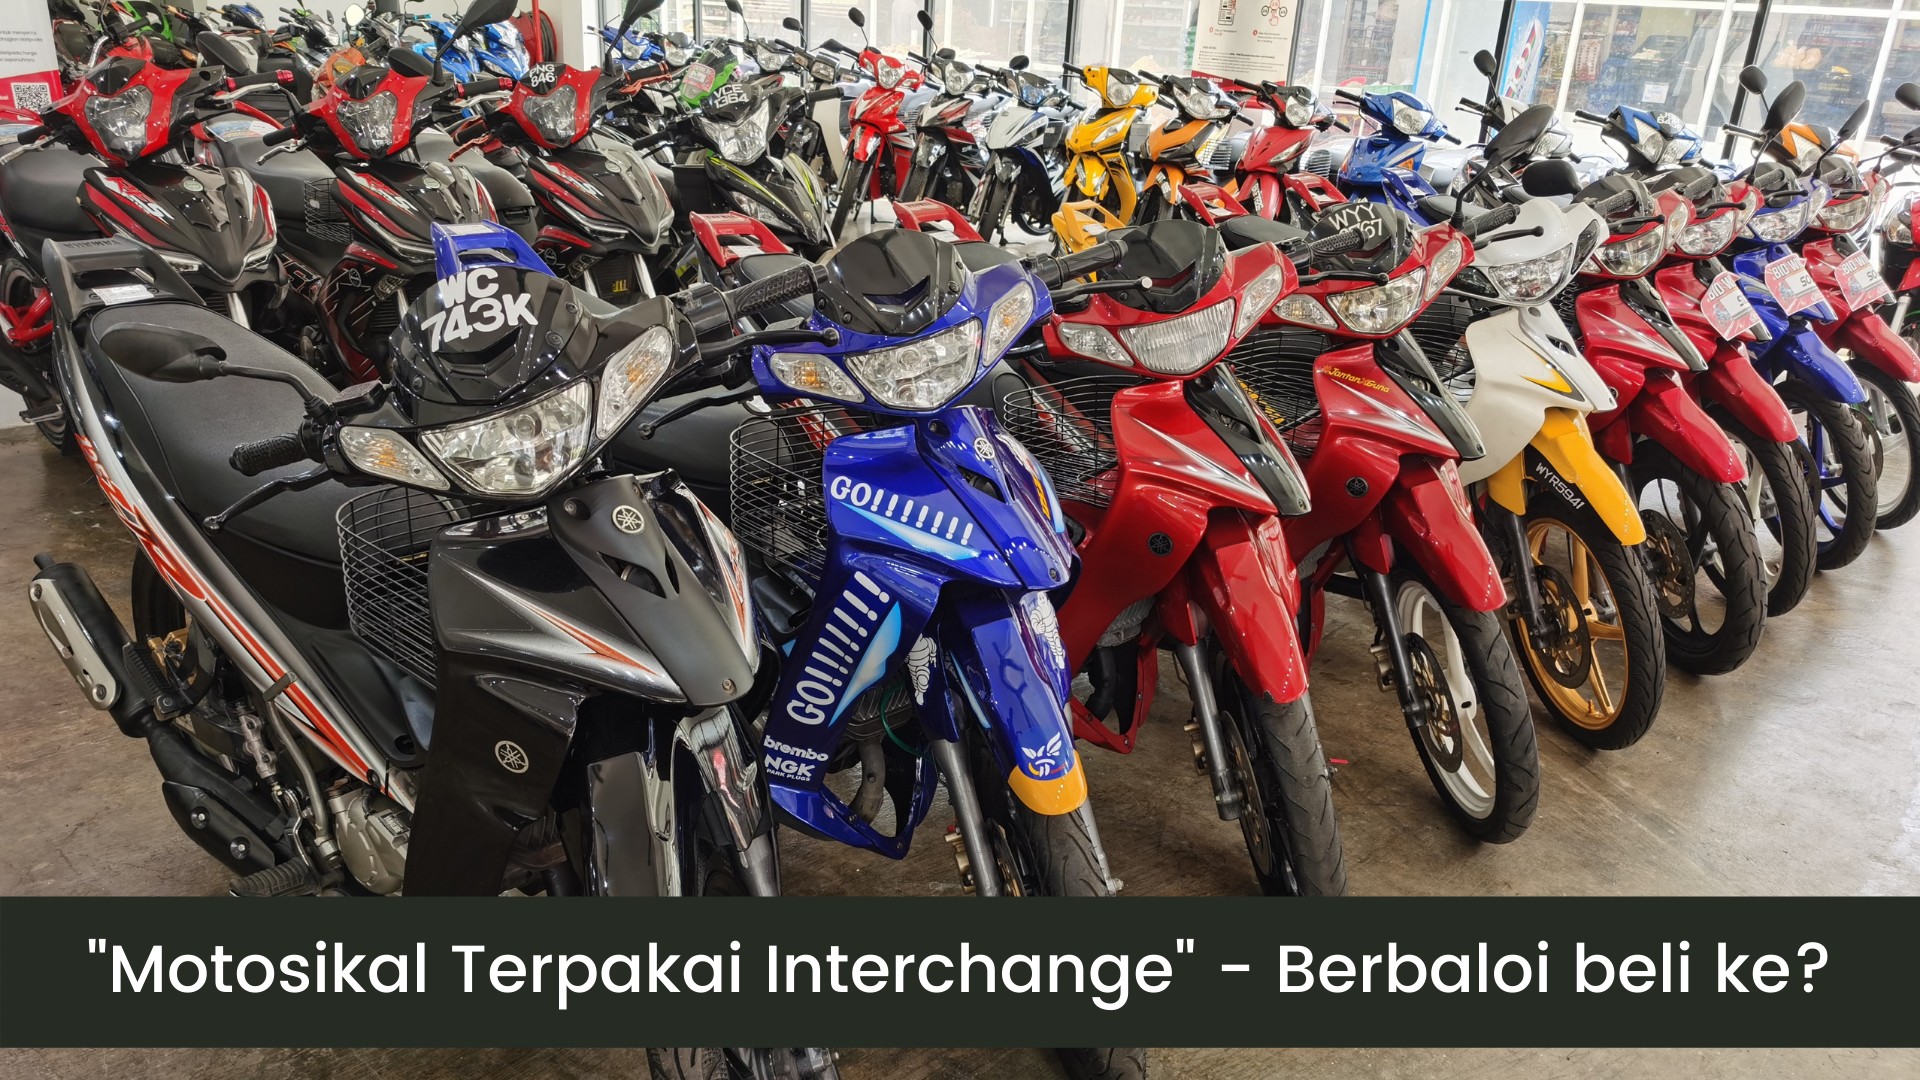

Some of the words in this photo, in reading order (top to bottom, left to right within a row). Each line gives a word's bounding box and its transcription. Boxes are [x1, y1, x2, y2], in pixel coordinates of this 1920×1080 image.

[529, 63, 555, 78] PNG
[531, 72, 555, 88] 846
[713, 84, 744, 99] VCE
[714, 93, 749, 109] 1364
[1328, 203, 1376, 231] WYY
[1339, 217, 1383, 240] 67
[437, 267, 499, 309] WC
[420, 293, 539, 353] 743K
[1535, 462, 1585, 510] WYR5941
[763, 734, 829, 762] brembo
[764, 753, 816, 778] NGK
[766, 768, 786, 778] PARK
